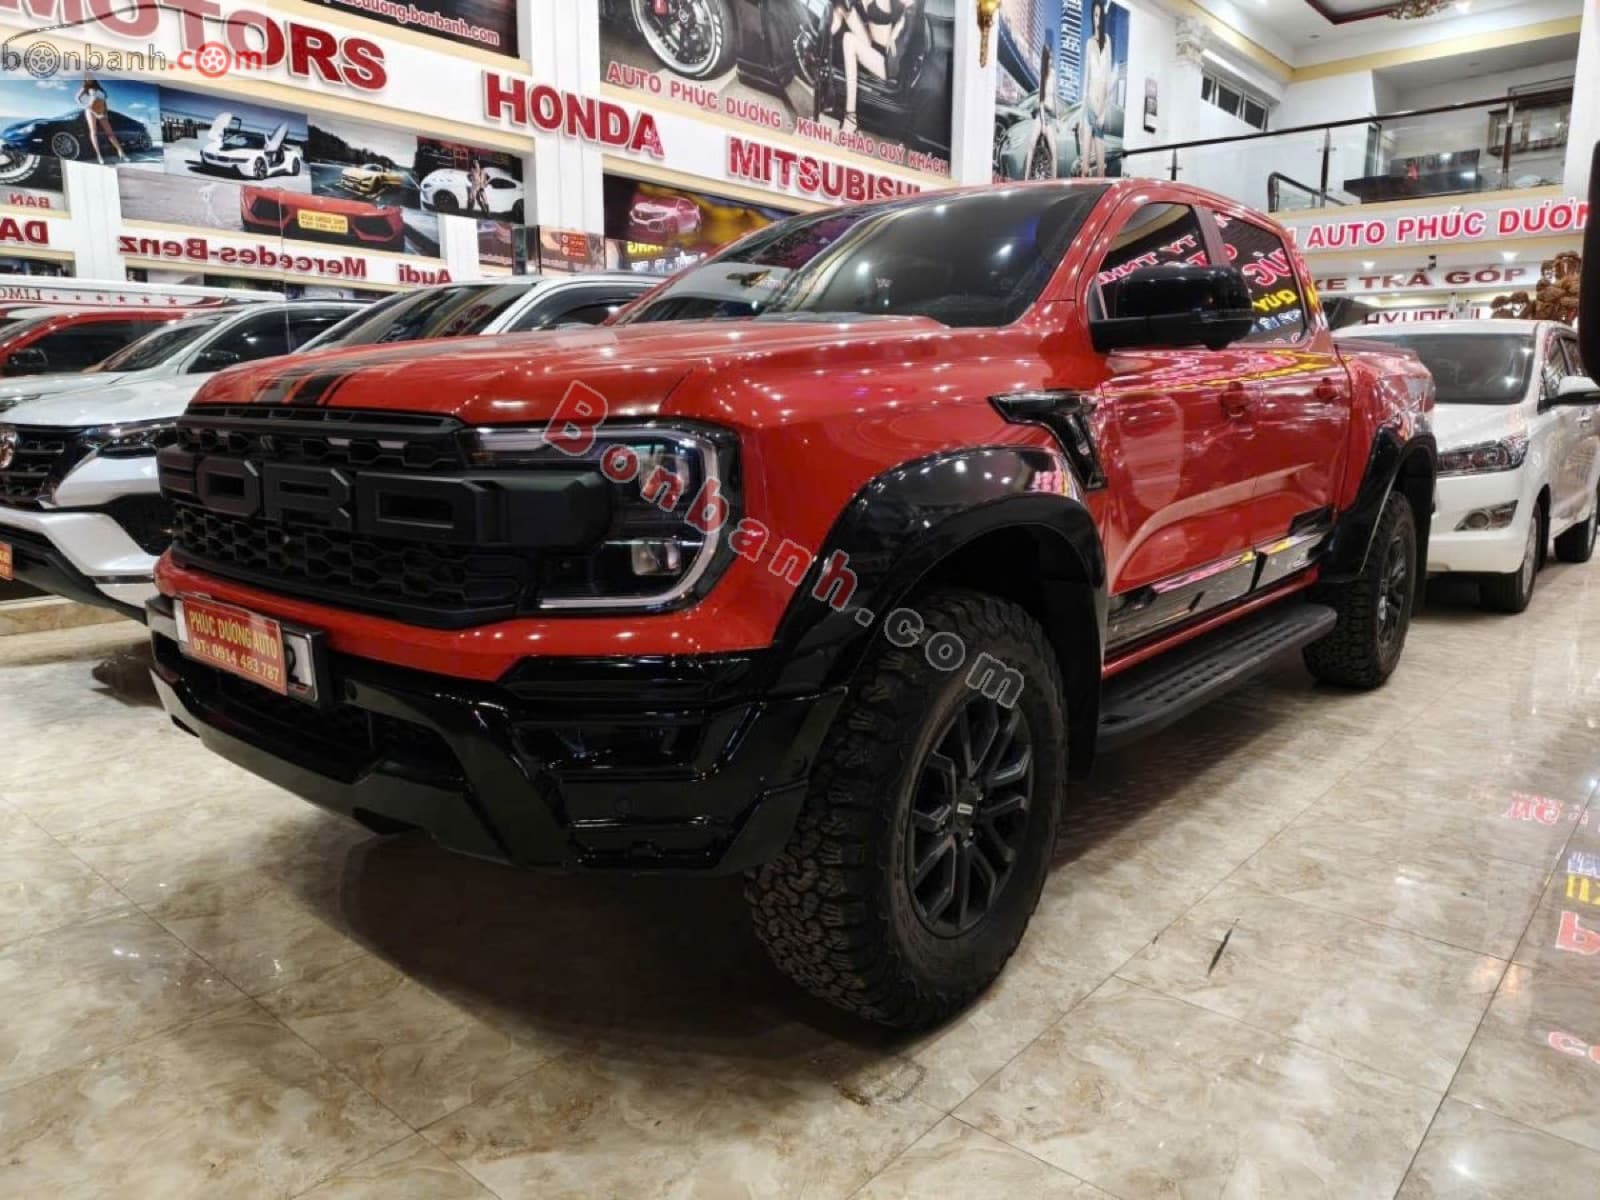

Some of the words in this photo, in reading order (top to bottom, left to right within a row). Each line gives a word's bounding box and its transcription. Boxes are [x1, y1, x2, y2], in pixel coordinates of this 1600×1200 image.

[606, 61, 663, 94] AUTO
[485, 71, 665, 159] HONDA
[728, 134, 921, 202] MITSUBIS
[1304, 219, 1387, 249] AUTO
[252, 631, 278, 659] AUTO
